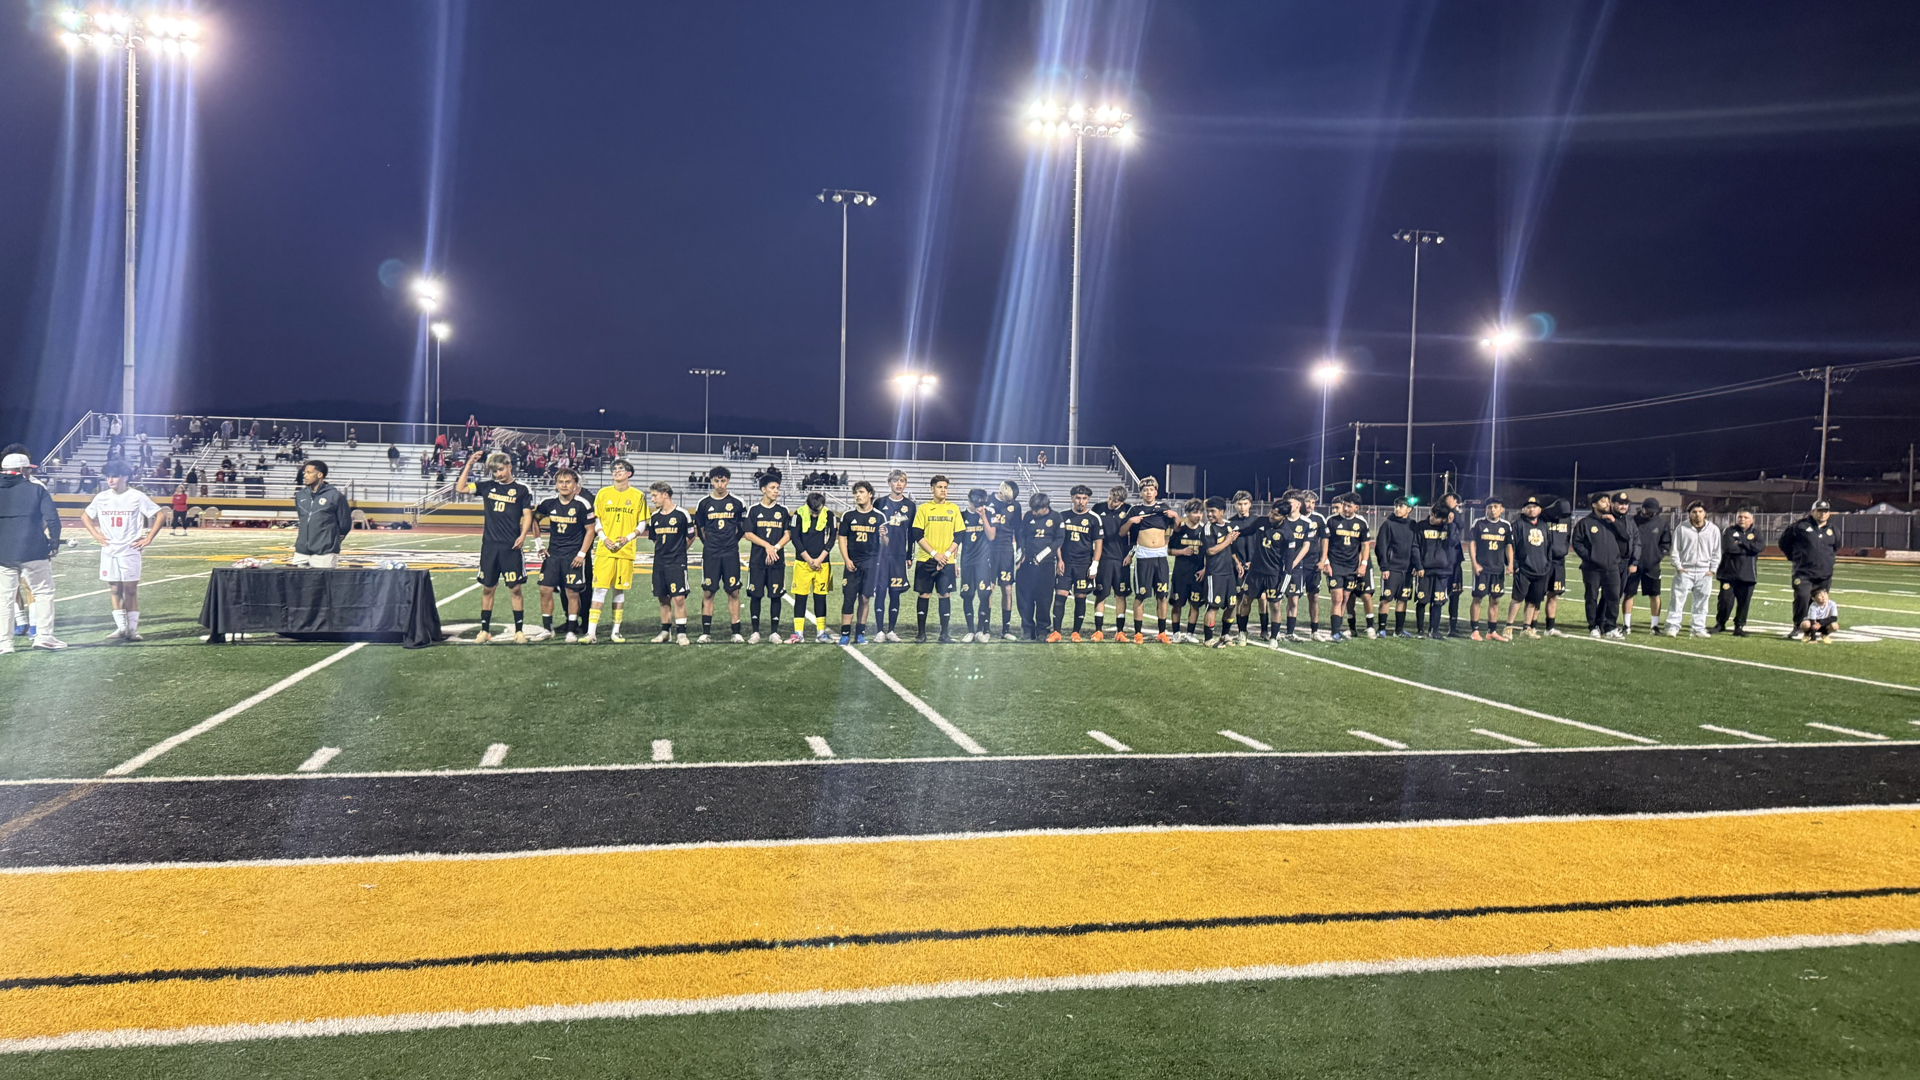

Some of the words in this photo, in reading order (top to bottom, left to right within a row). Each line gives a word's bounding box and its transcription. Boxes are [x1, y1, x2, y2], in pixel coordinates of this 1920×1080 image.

[493, 501, 506, 512] 10
[557, 523, 568, 533] 17
[718, 520, 725, 529] 9
[765, 528, 772, 538] 7
[856, 532, 868, 542] 20
[970, 532, 977, 542] 6
[1070, 532, 1080, 541] 15
[1344, 536, 1351, 545] 11
[1488, 541, 1498, 550] 16
[504, 572, 517, 582] 10
[566, 574, 576, 584] 17
[617, 575, 622, 585] 1
[729, 576, 736, 586] 9
[1001, 571, 1011, 581] 26
[820, 582, 826, 591] 2
[890, 578, 903, 587] 22
[979, 580, 986, 590] 6
[1076, 580, 1086, 589] 15
[1119, 582, 1126, 592] 5
[670, 583, 677, 593] 8
[772, 584, 779, 594] 7
[1157, 583, 1167, 593] 24
[1289, 584, 1296, 593] 3
[1491, 583, 1500, 593] 16
[1190, 591, 1200, 602] 25
[1266, 589, 1277, 598] 12
